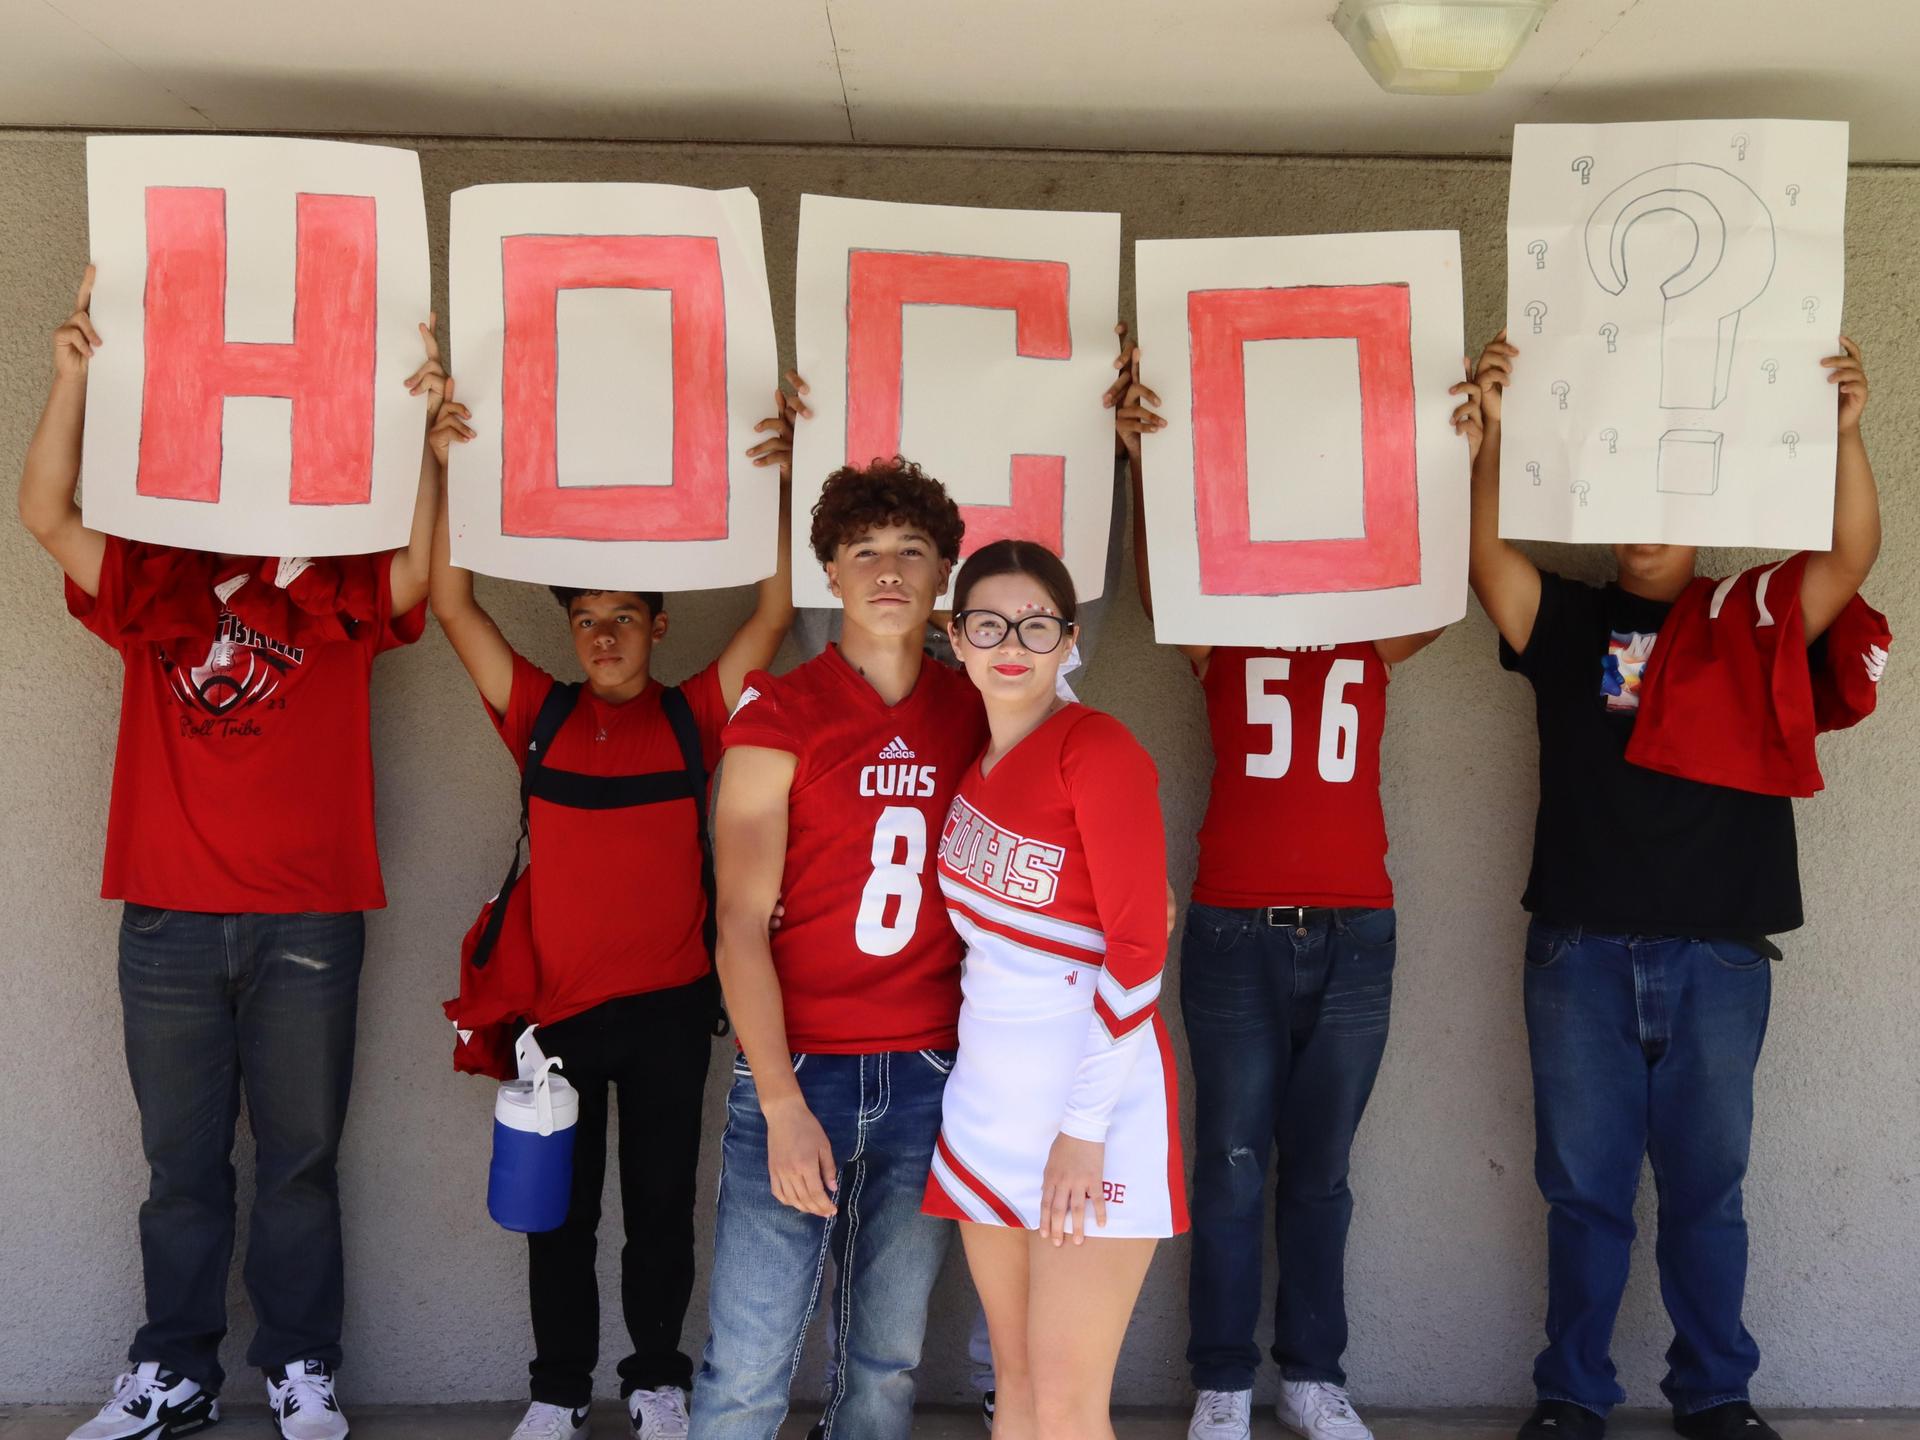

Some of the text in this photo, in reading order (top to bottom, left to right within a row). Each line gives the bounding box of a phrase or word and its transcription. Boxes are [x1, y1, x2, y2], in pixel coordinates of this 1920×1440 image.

[136, 186, 377, 505] H
[501, 232, 730, 542] O
[1585, 162, 1776, 496] ?
[845, 247, 1073, 559] C
[1188, 281, 1422, 597] O
[1628, 633, 1658, 656] NI
[180, 714, 263, 738] Roll Tribe
[859, 764, 937, 798] CUHS
[878, 748, 916, 759] adidas
[1245, 656, 1365, 783] 56
[854, 805, 927, 957] 8
[1085, 1181, 1127, 1204] BE
